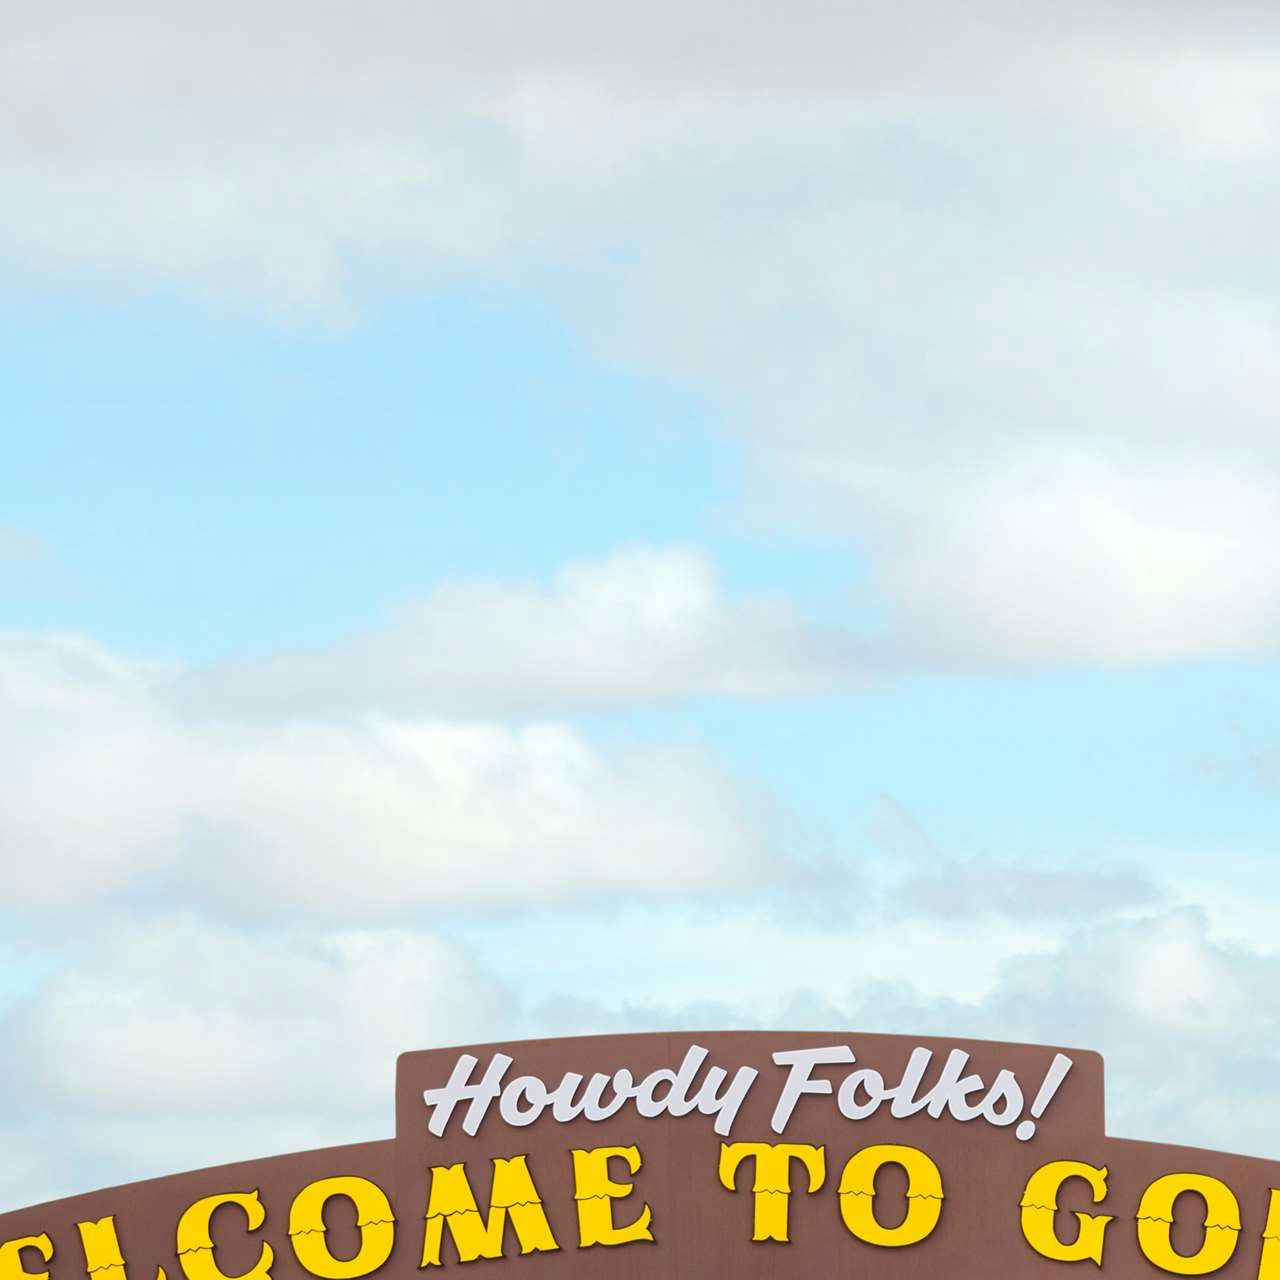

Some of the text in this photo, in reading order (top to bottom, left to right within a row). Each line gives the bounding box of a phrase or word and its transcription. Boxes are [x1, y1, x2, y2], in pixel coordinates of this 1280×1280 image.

[422, 1045, 1073, 1141] Howdy Folks!
[719, 1141, 945, 1247] TO
